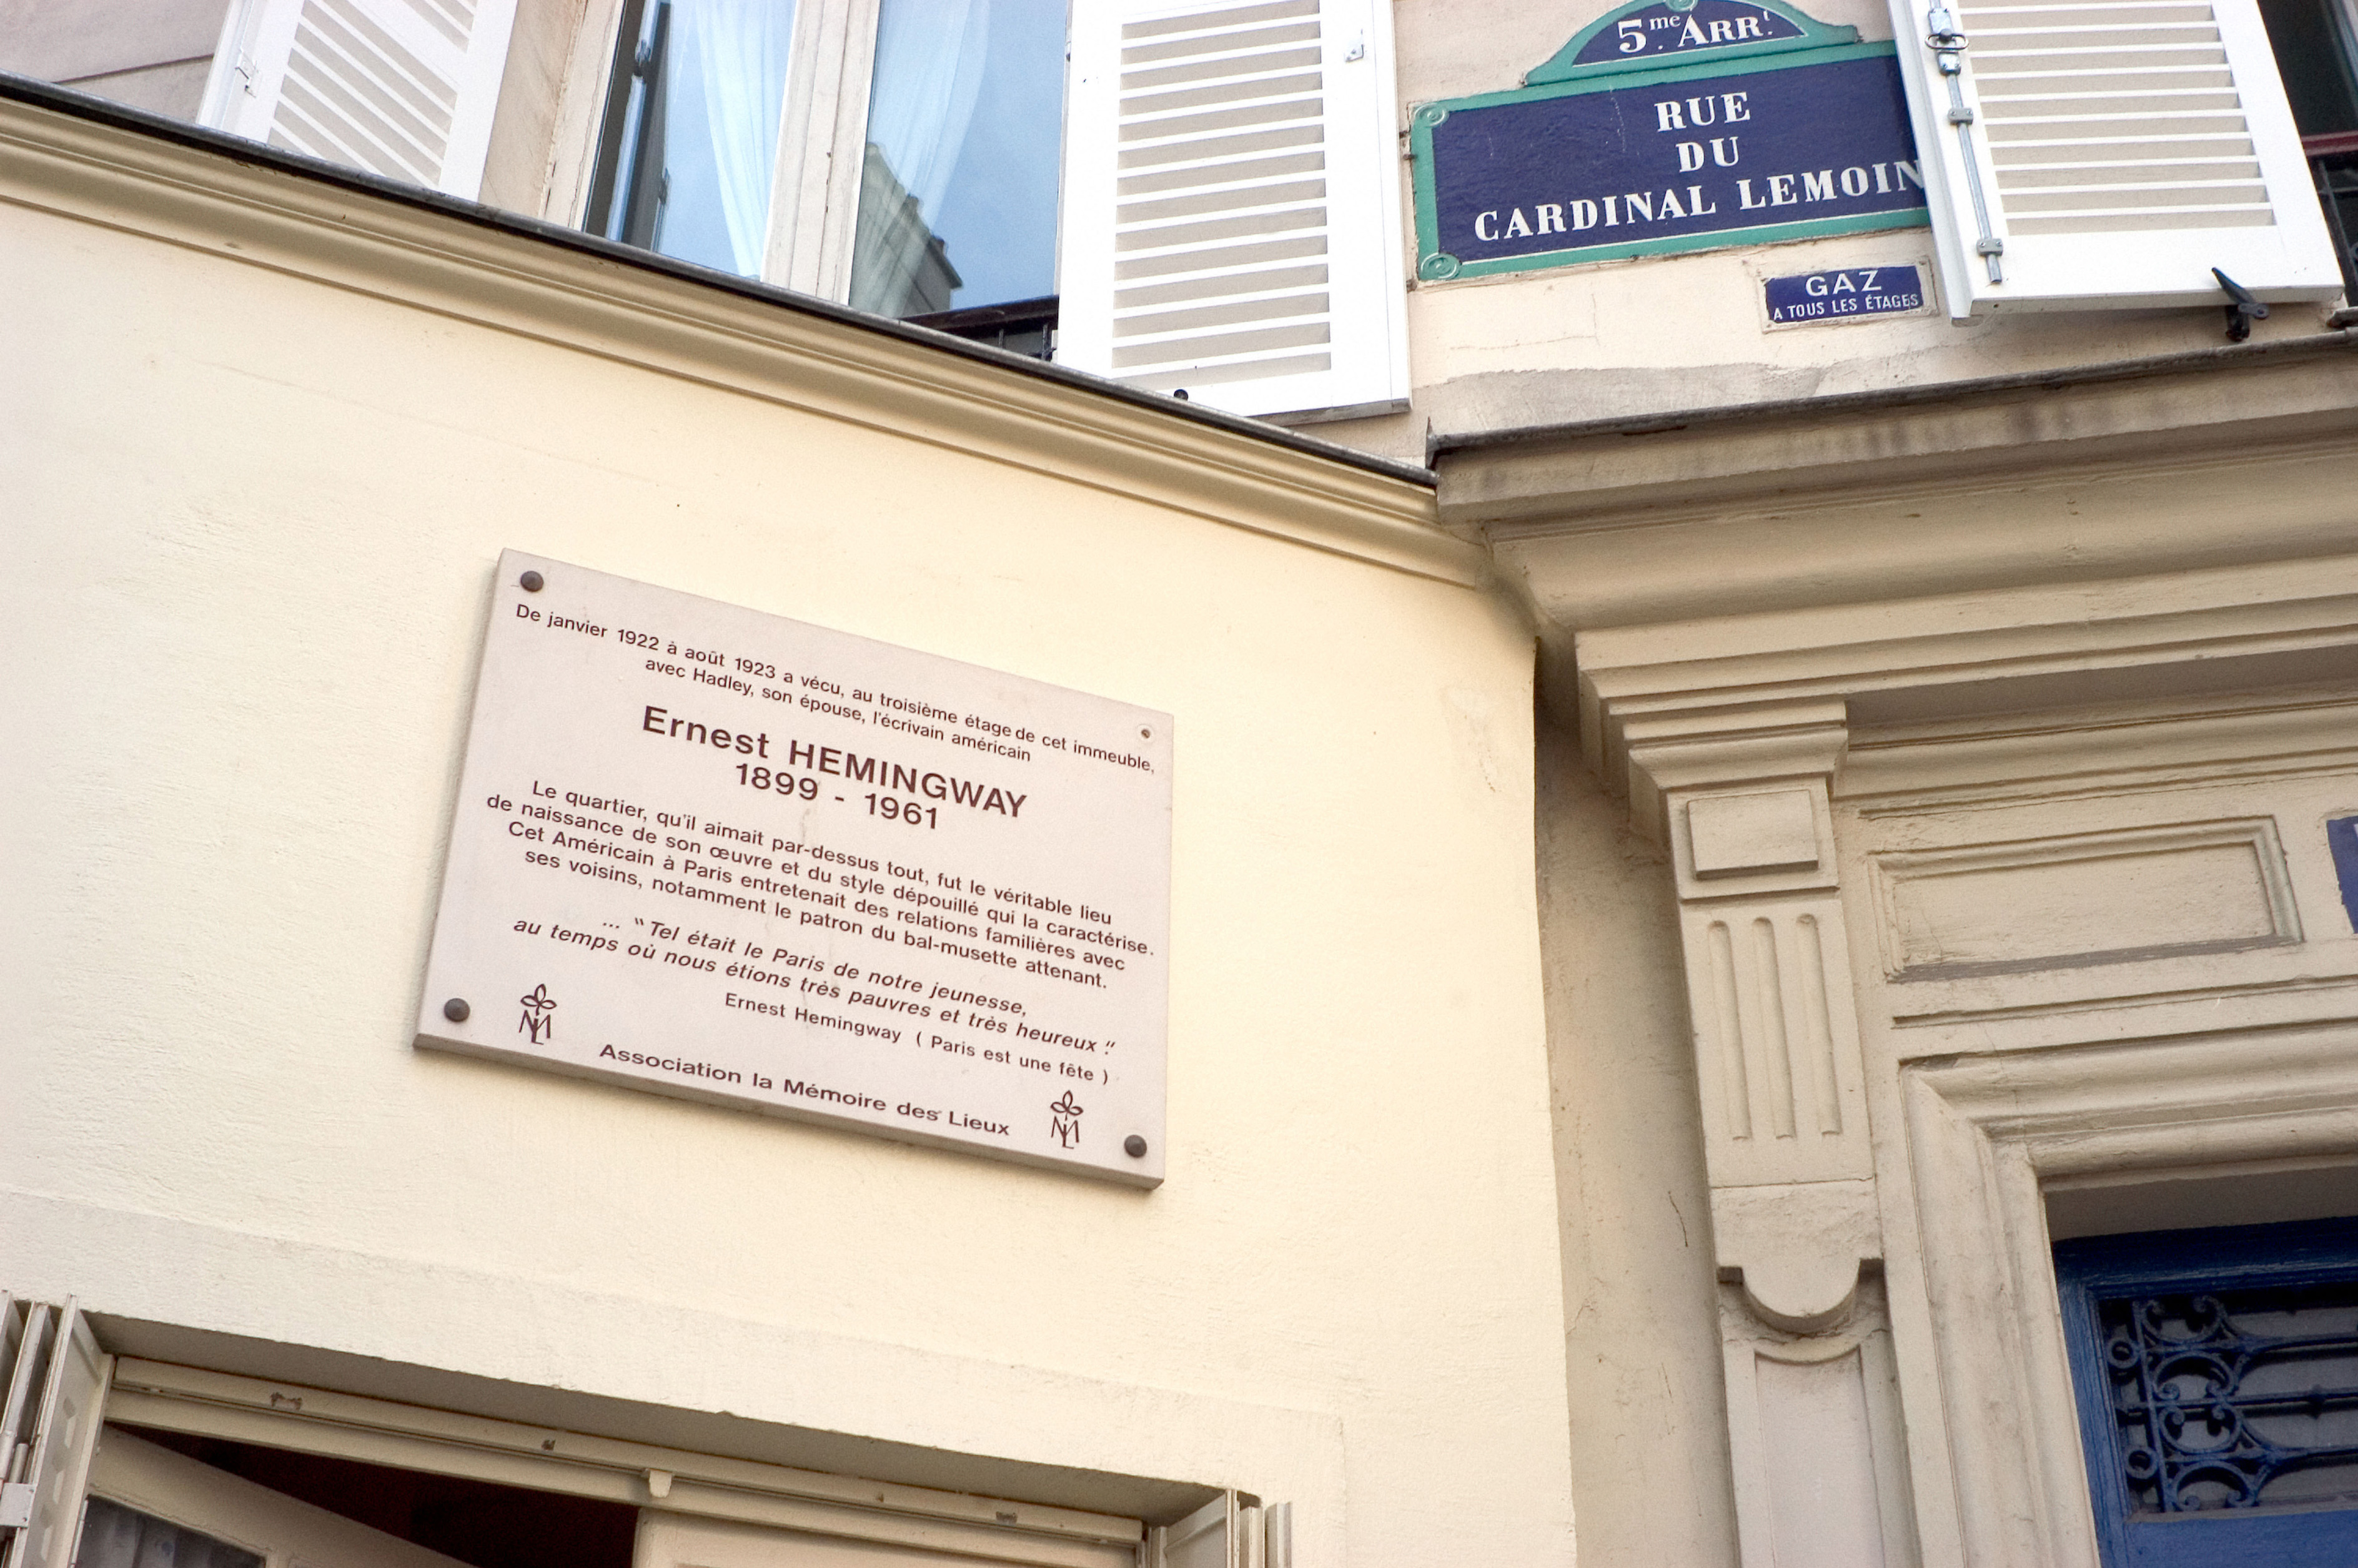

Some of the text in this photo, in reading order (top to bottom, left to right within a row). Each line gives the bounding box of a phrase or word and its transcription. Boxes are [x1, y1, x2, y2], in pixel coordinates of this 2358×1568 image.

[1654, 92, 1750, 132] RUE
[1675, 136, 1740, 173] DU
[1474, 185, 1716, 241] CARDINAL
[1773, 293, 1919, 321] A TOUS LES ÉTAGES
[1805, 270, 1882, 297] GAZ
[516, 603, 1154, 774] De janvier 1922 à août 1923 a vécu, au troisième étage de cet immeuble,
[645, 659, 1031, 762] avec Hadley, son épouse, l'écrivain américain
[642, 705, 1028, 818] Ernest HEMINGWAY
[735, 762, 818, 801] 1899
[864, 792, 937, 830] 1961
[487, 794, 1154, 956] de naissance de son œuvre et du style dépouillé qui la caractérise.
[508, 821, 1125, 971] Cet Américain à Paris entretenait des relations familières avec
[532, 780, 1111, 925] Le quartier, qu'il aimait par-dessus tout, fut le véritable lieu
[525, 851, 1107, 989] ses voisins, notamment le patron du bal-musette attenant.
[513, 920, 542, 935] au
[550, 924, 619, 952] temps
[627, 944, 656, 960] où
[663, 951, 717, 972] nous
[725, 962, 791, 988] étions
[800, 977, 841, 998] très
[847, 990, 931, 1017] pauvres
[939, 1009, 961, 1024] et
[968, 1012, 1008, 1033] très
[687, 930, 736, 954] était
[743, 942, 763, 959] le
[771, 948, 825, 972] Paris
[833, 962, 859, 980] de
[868, 972, 923, 993] notre
[928, 982, 1026, 1017] jeunesse,
[725, 992, 786, 1018] Ernest
[795, 1007, 901, 1044] Hemingway
[931, 1035, 976, 1057] Paris
[983, 1049, 1011, 1064] est
[1019, 1057, 1051, 1072] une
[1059, 1062, 1094, 1081] fête
[599, 1043, 1009, 1136] Association la Mémoire des Lieux
